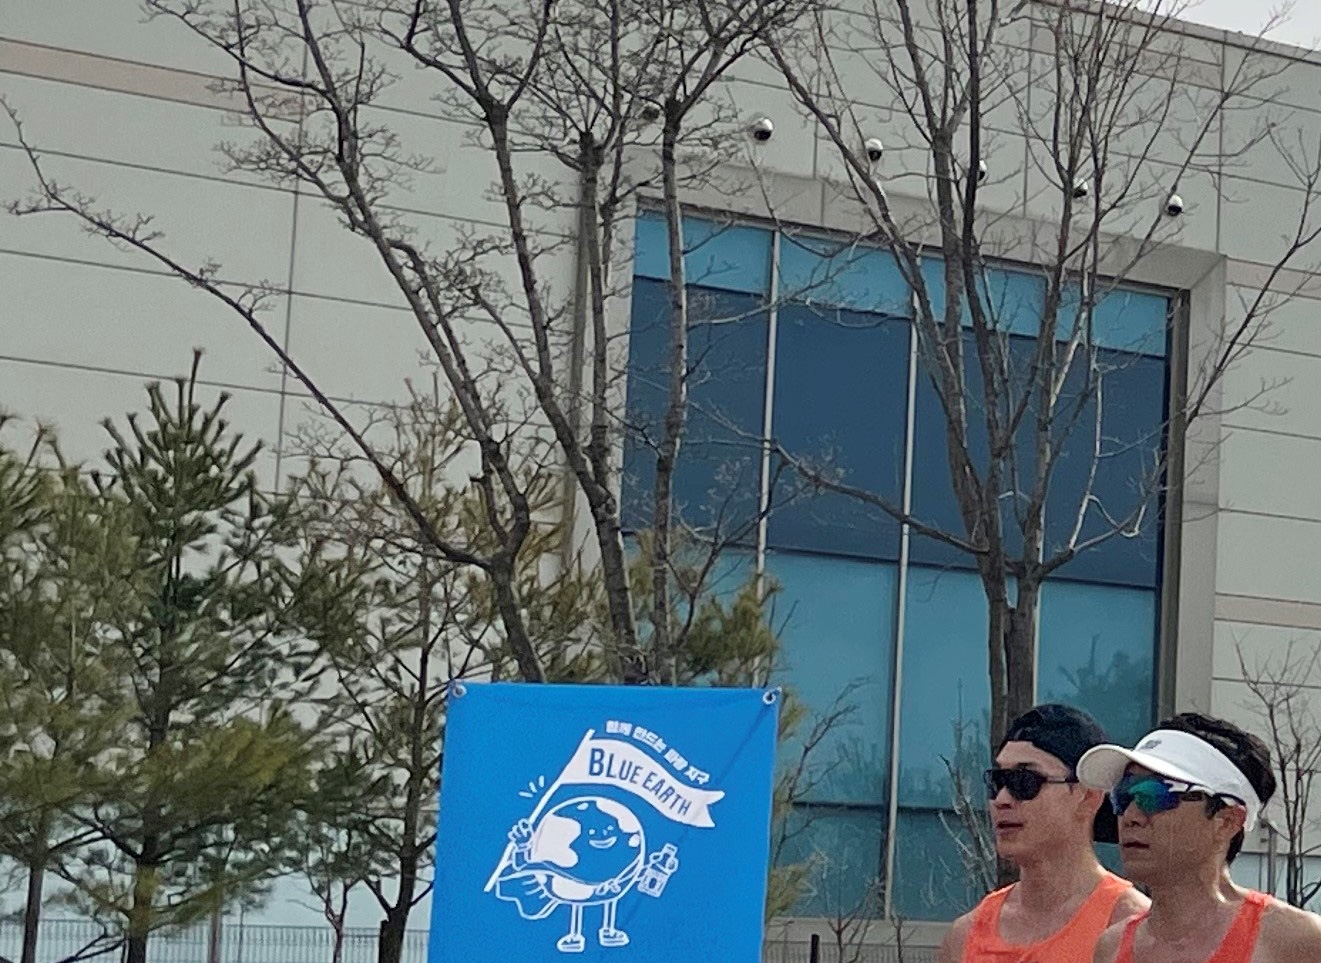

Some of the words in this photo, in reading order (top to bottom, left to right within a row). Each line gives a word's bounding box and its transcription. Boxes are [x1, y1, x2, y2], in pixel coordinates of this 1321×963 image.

[589, 748, 643, 784] BLUE
[642, 772, 692, 816] EARTH
[684, 765, 710, 785] 지구
